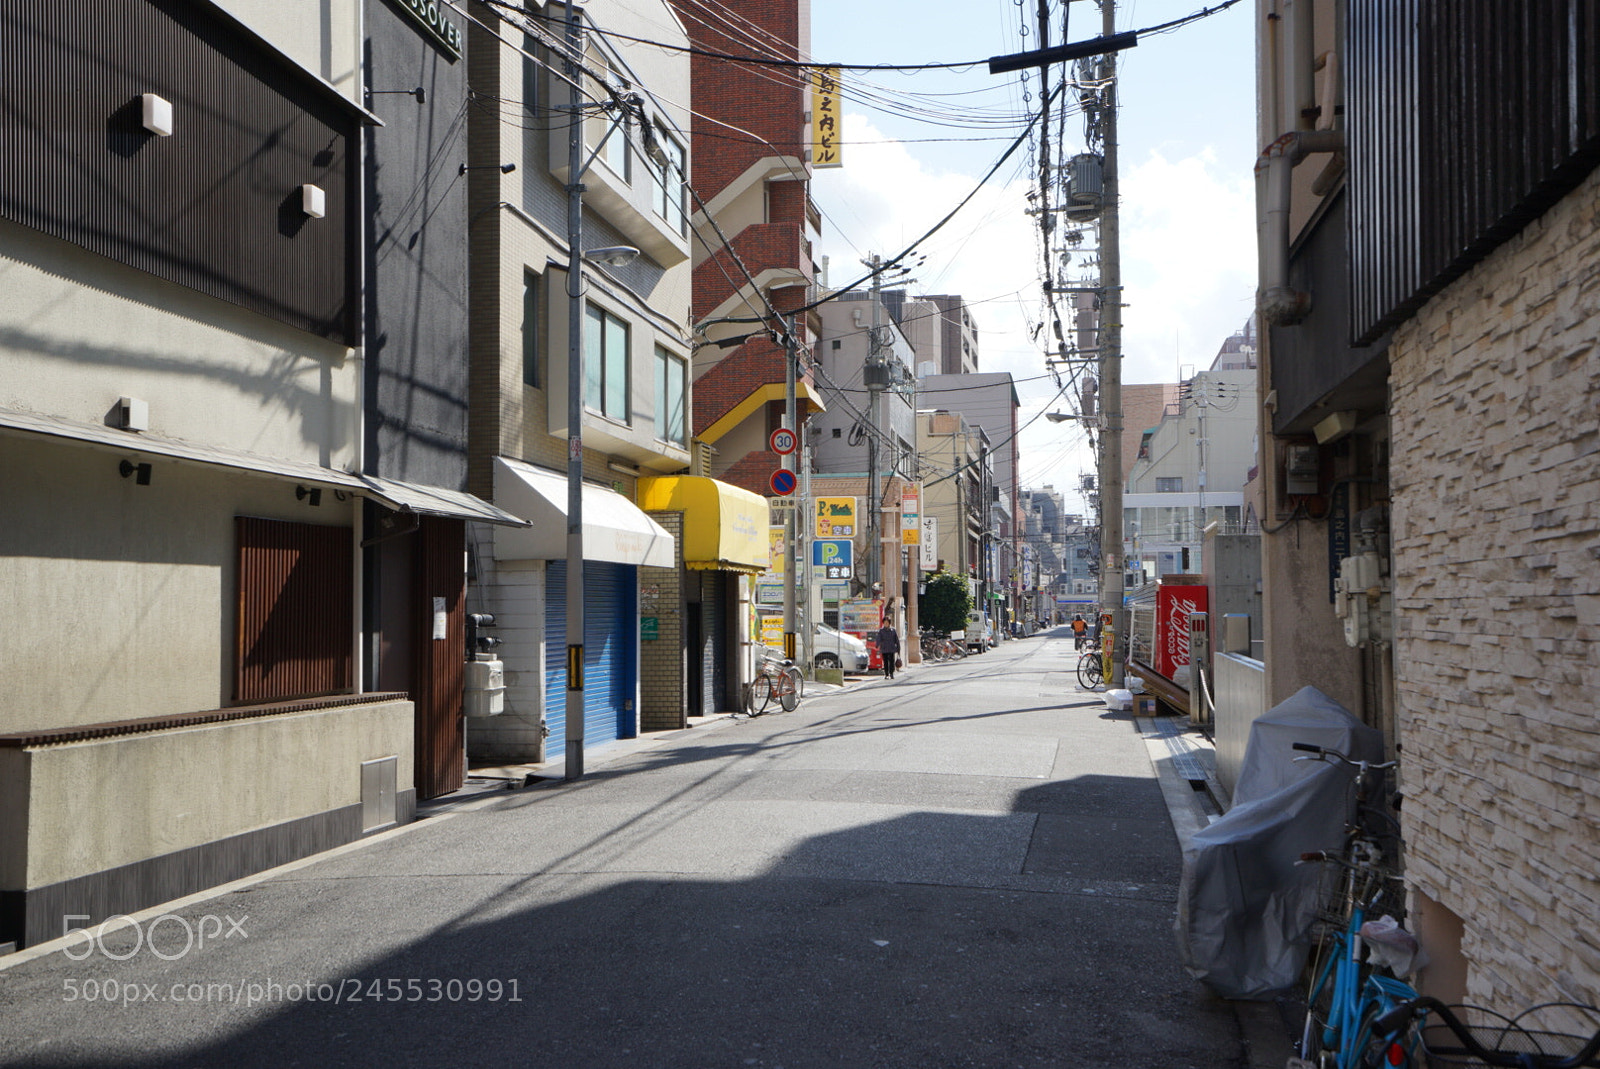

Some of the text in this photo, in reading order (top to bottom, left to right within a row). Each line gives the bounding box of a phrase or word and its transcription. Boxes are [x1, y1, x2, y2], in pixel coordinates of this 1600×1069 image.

[776, 435, 792, 448] 30
[772, 499, 796, 508] 自動車
[832, 525, 852, 535] 空車
[821, 542, 839, 564] P
[829, 566, 851, 578] 空車
